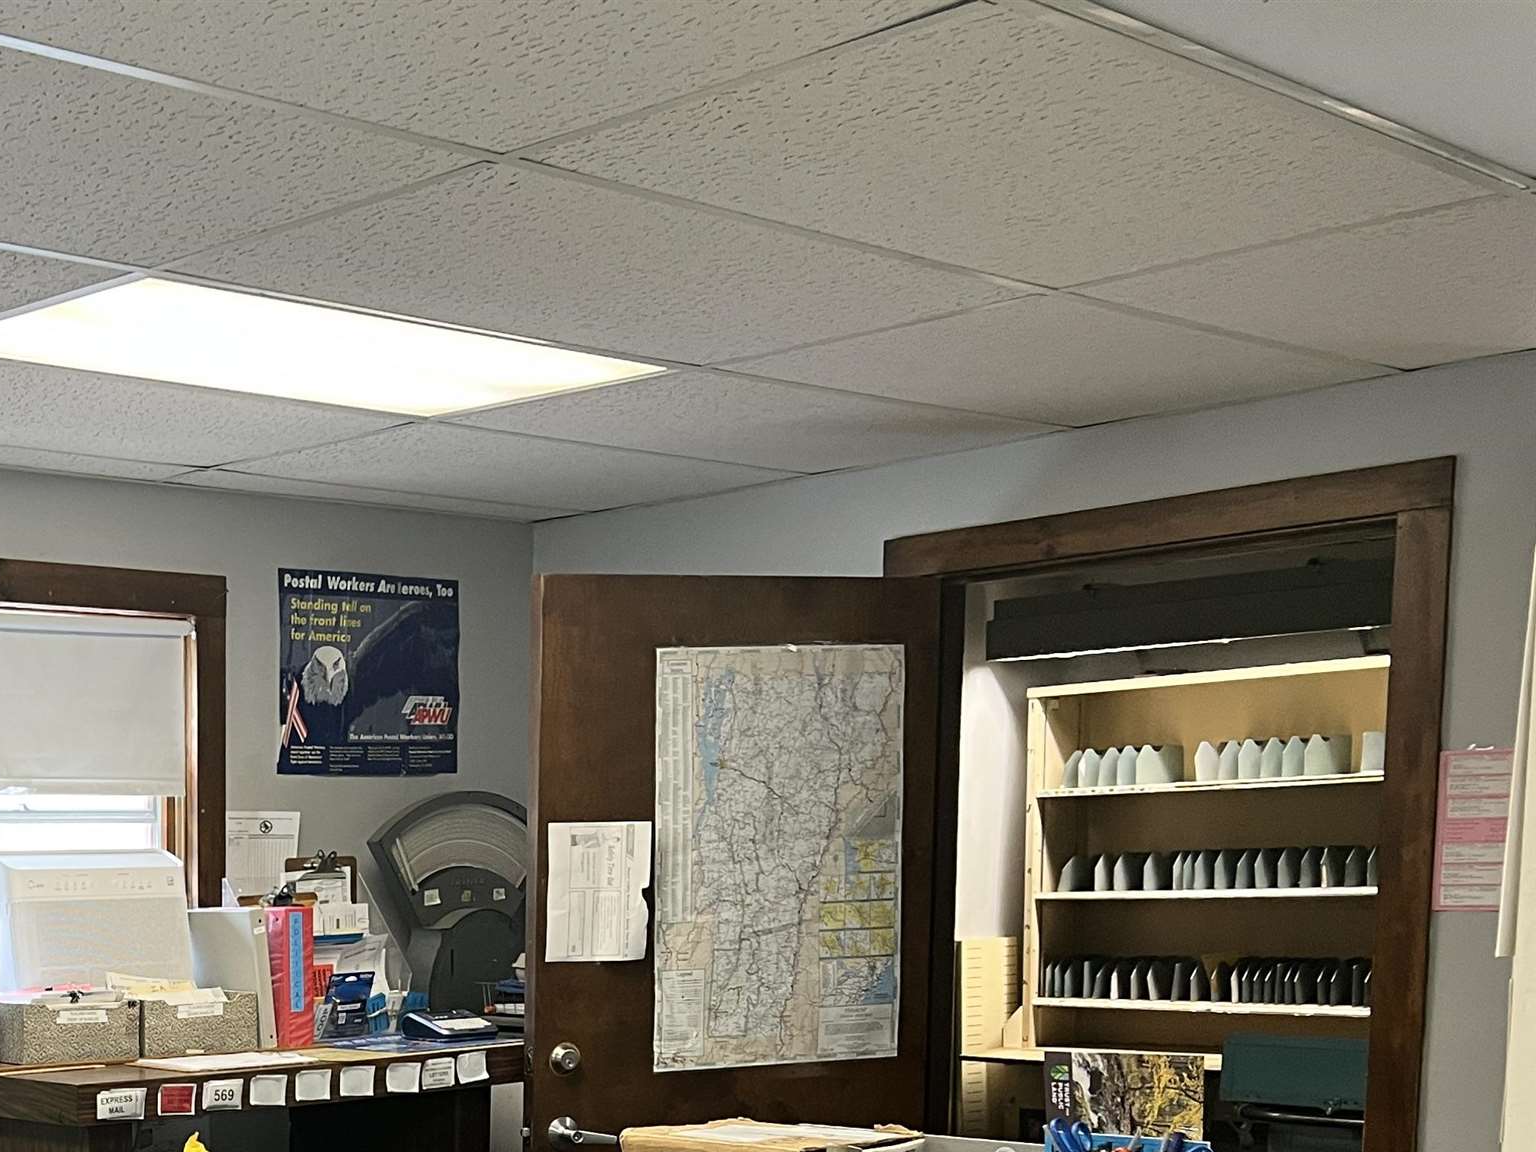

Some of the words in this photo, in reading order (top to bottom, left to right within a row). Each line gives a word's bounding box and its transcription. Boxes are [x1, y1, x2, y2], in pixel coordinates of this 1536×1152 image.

[284, 573, 322, 590] Postal
[327, 575, 374, 592] Workers
[378, 579, 396, 593] Are
[398, 581, 433, 598] eroes,
[436, 584, 454, 598] Too
[290, 597, 338, 614] Standing
[359, 603, 372, 613] on
[290, 613, 307, 626] the
[290, 630, 306, 641] for
[308, 631, 351, 643] America
[100, 1094, 133, 1105] EXPRESS
[214, 1089, 234, 1102] 569
[109, 1106, 125, 1115] MAIL
